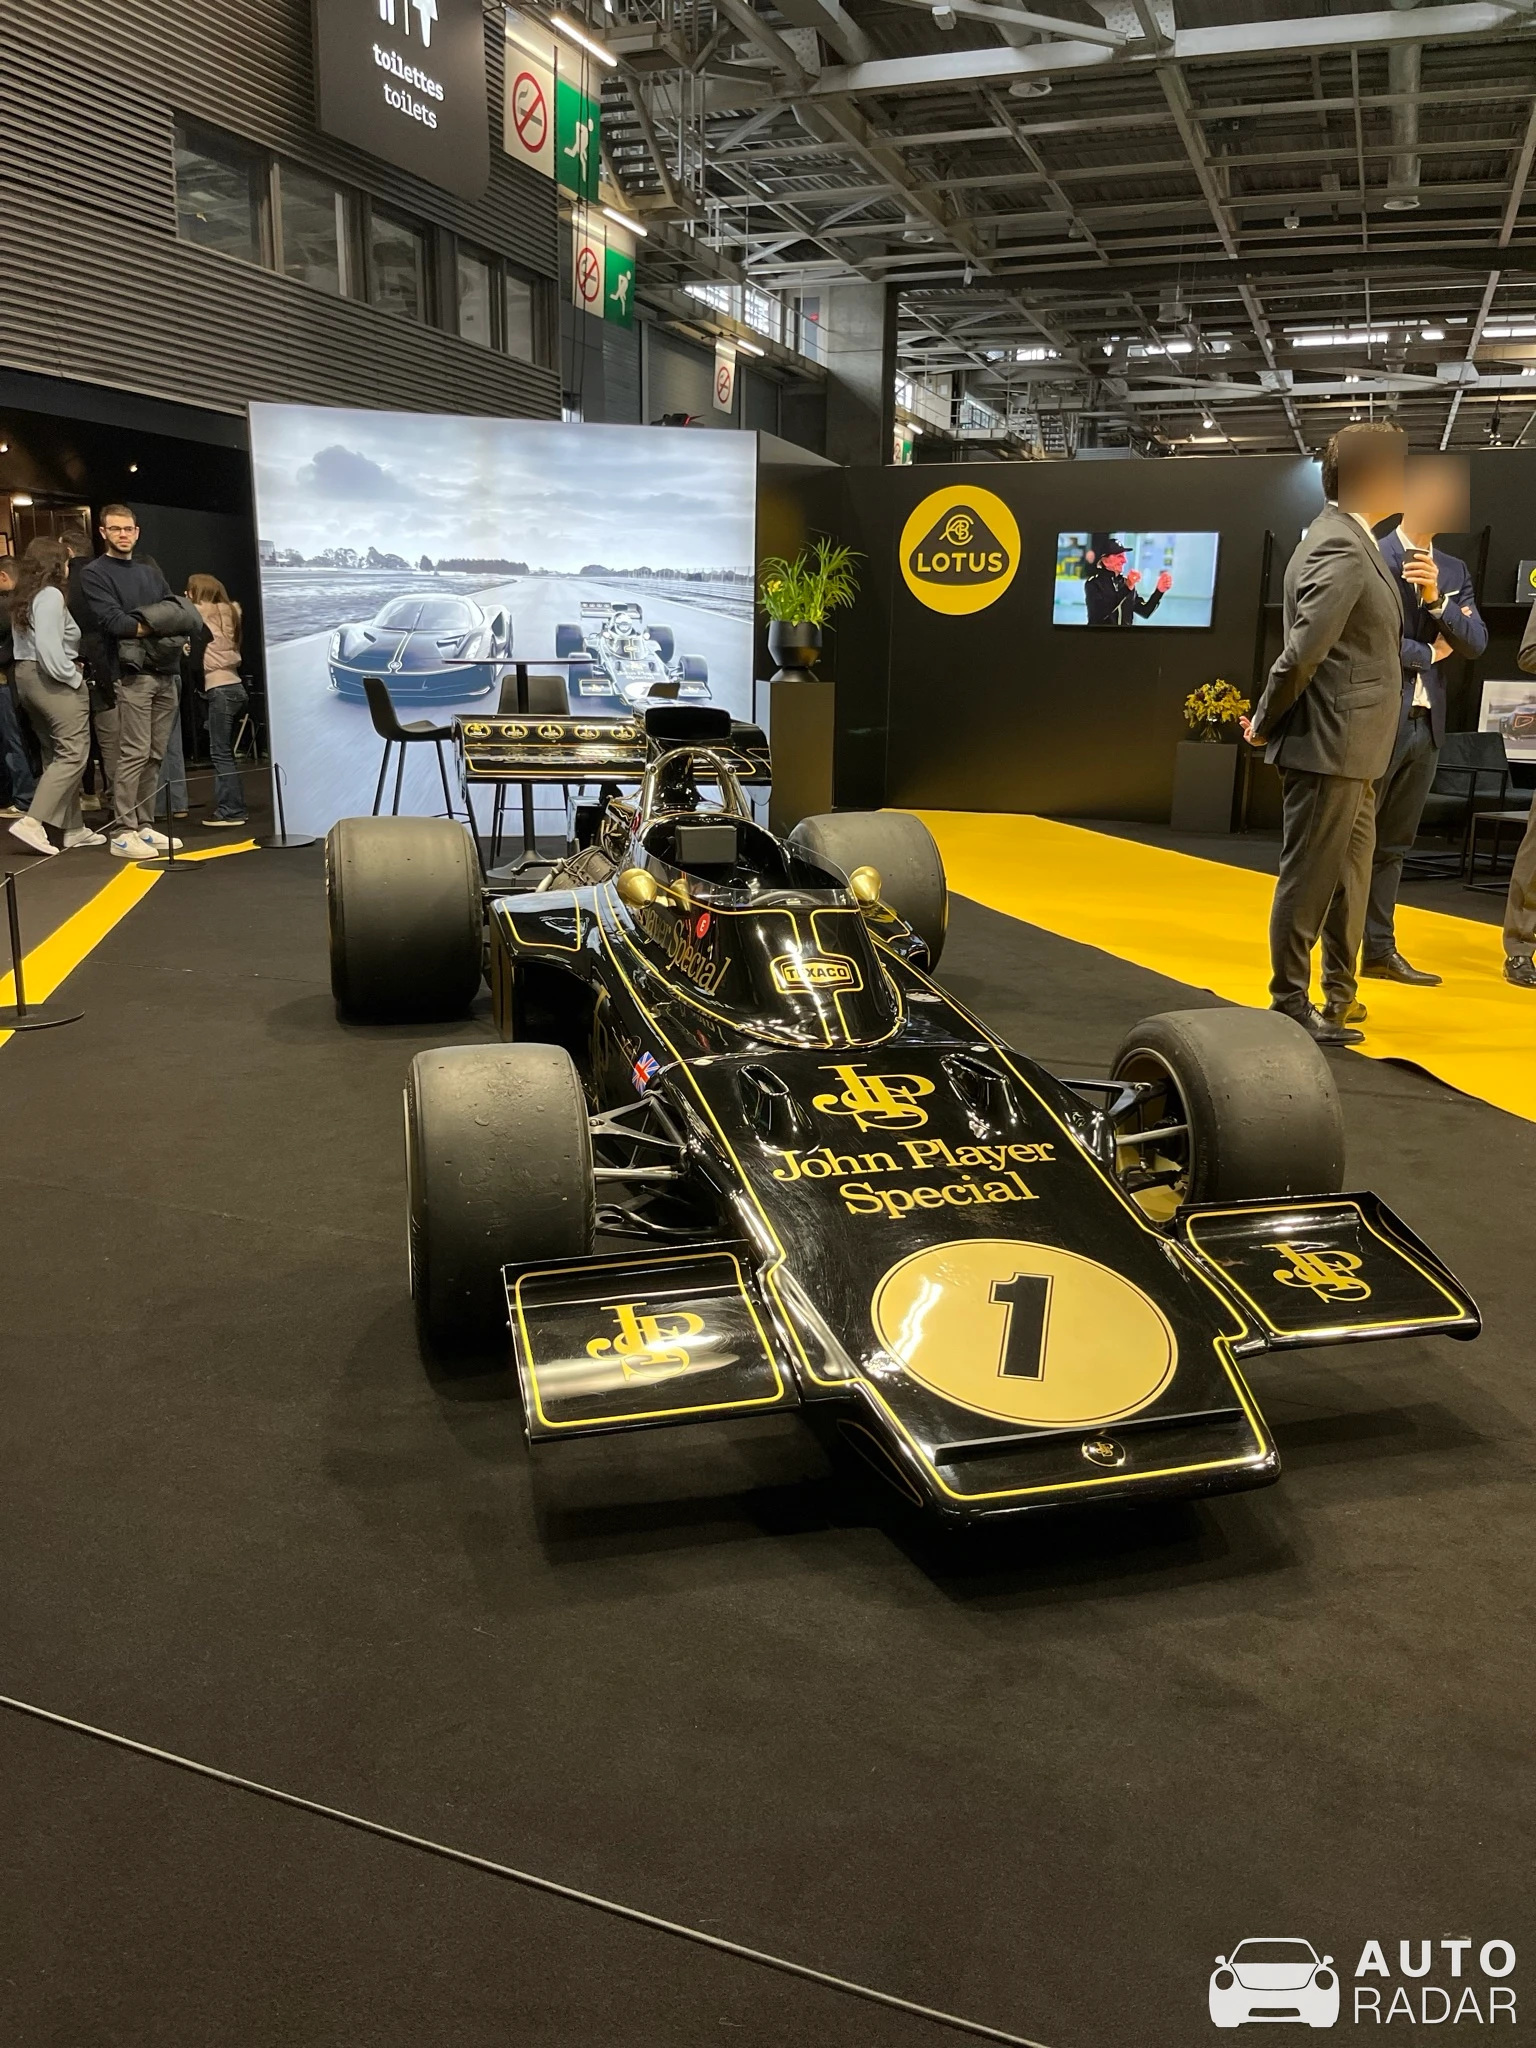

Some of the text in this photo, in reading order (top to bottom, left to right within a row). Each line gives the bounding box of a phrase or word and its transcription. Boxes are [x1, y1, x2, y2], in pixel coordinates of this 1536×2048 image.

[372, 43, 444, 101] toilettes
[383, 83, 438, 129] toilets
[917, 552, 1003, 573] LOTUS
[700, 919, 707, 932] E
[665, 919, 732, 997] Special
[786, 967, 848, 979] TXACO
[812, 1064, 936, 1132] JPS
[773, 1138, 1056, 1182] John Player
[839, 1171, 1040, 1219] Special
[988, 1272, 1055, 1382] 1
